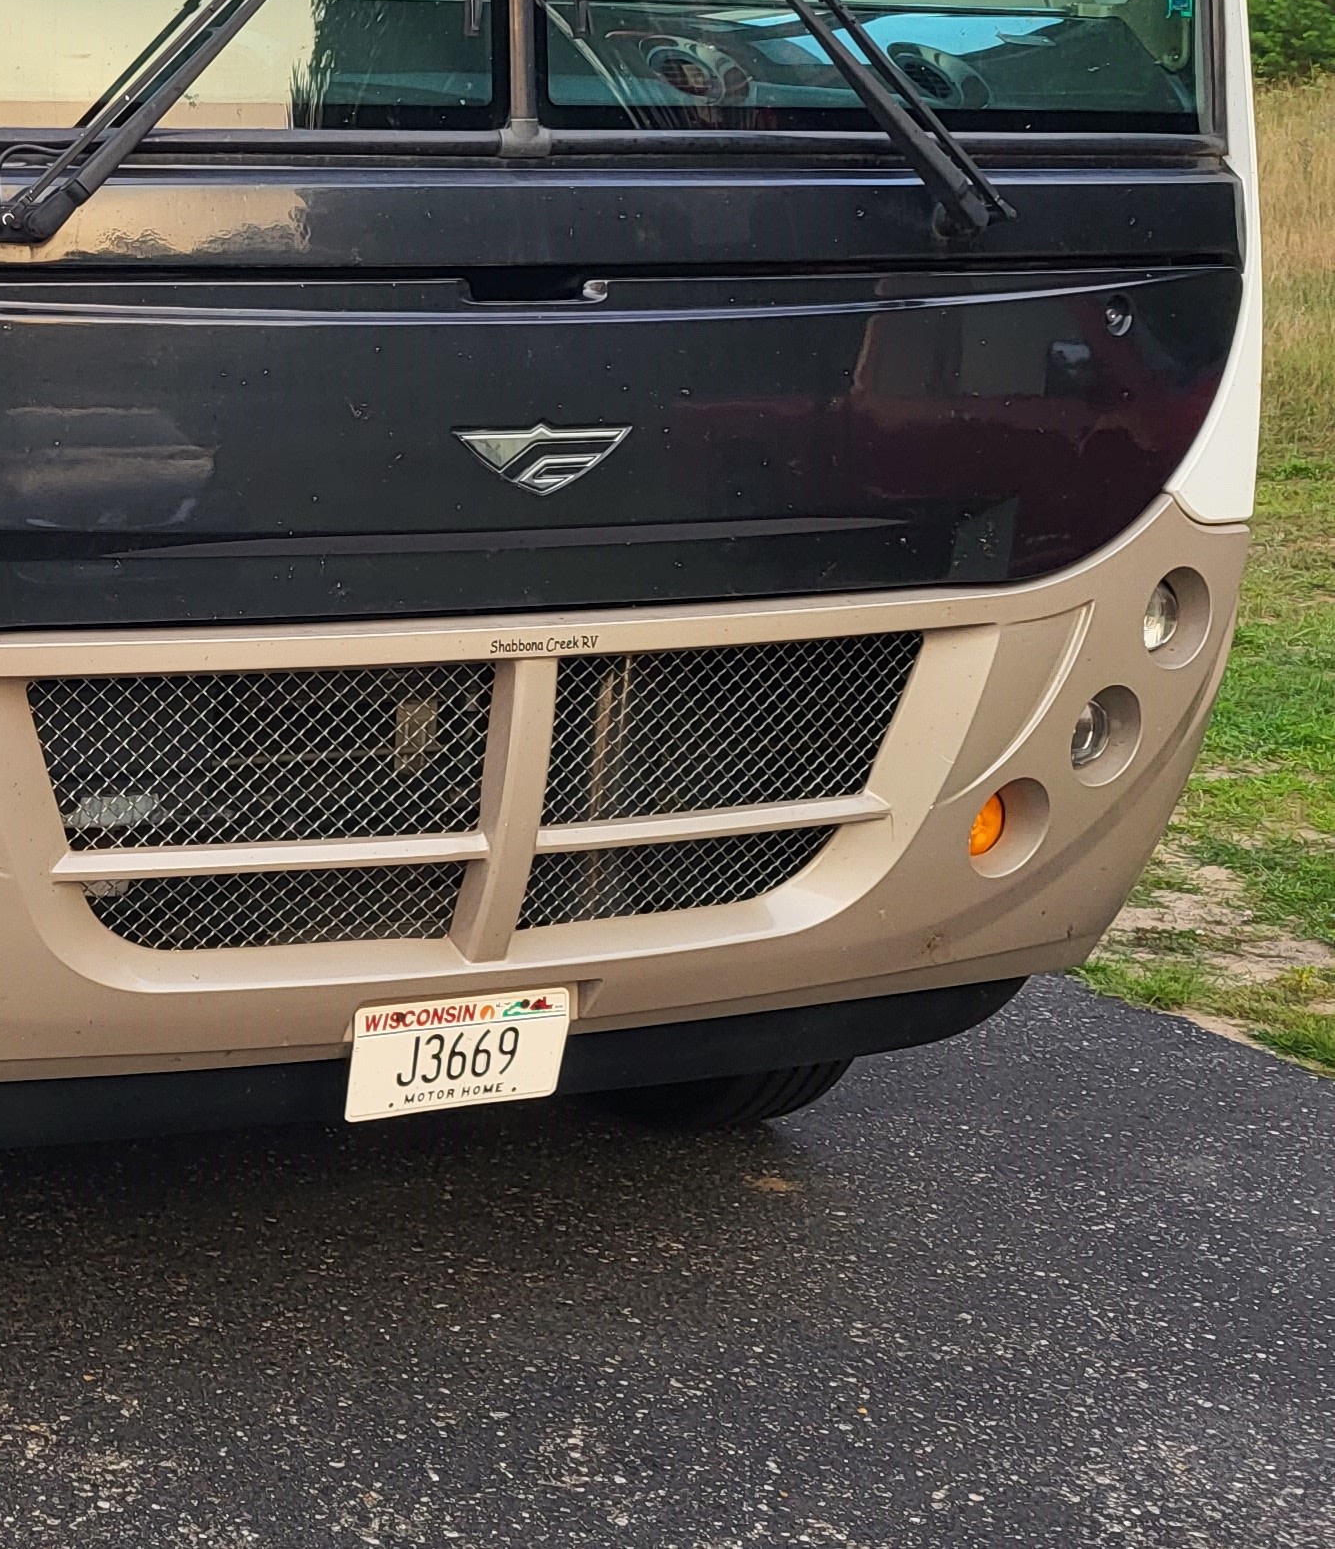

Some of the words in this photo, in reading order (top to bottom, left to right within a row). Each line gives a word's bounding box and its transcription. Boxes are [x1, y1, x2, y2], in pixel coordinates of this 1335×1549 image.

[489, 638, 544, 654] Shabbona
[546, 635, 579, 652] Creek
[581, 635, 599, 649] RV
[364, 1004, 477, 1032] WISCONSIN
[396, 1026, 520, 1087] J3669
[403, 1088, 455, 1105] MOTOR
[461, 1082, 504, 1098] HOME
